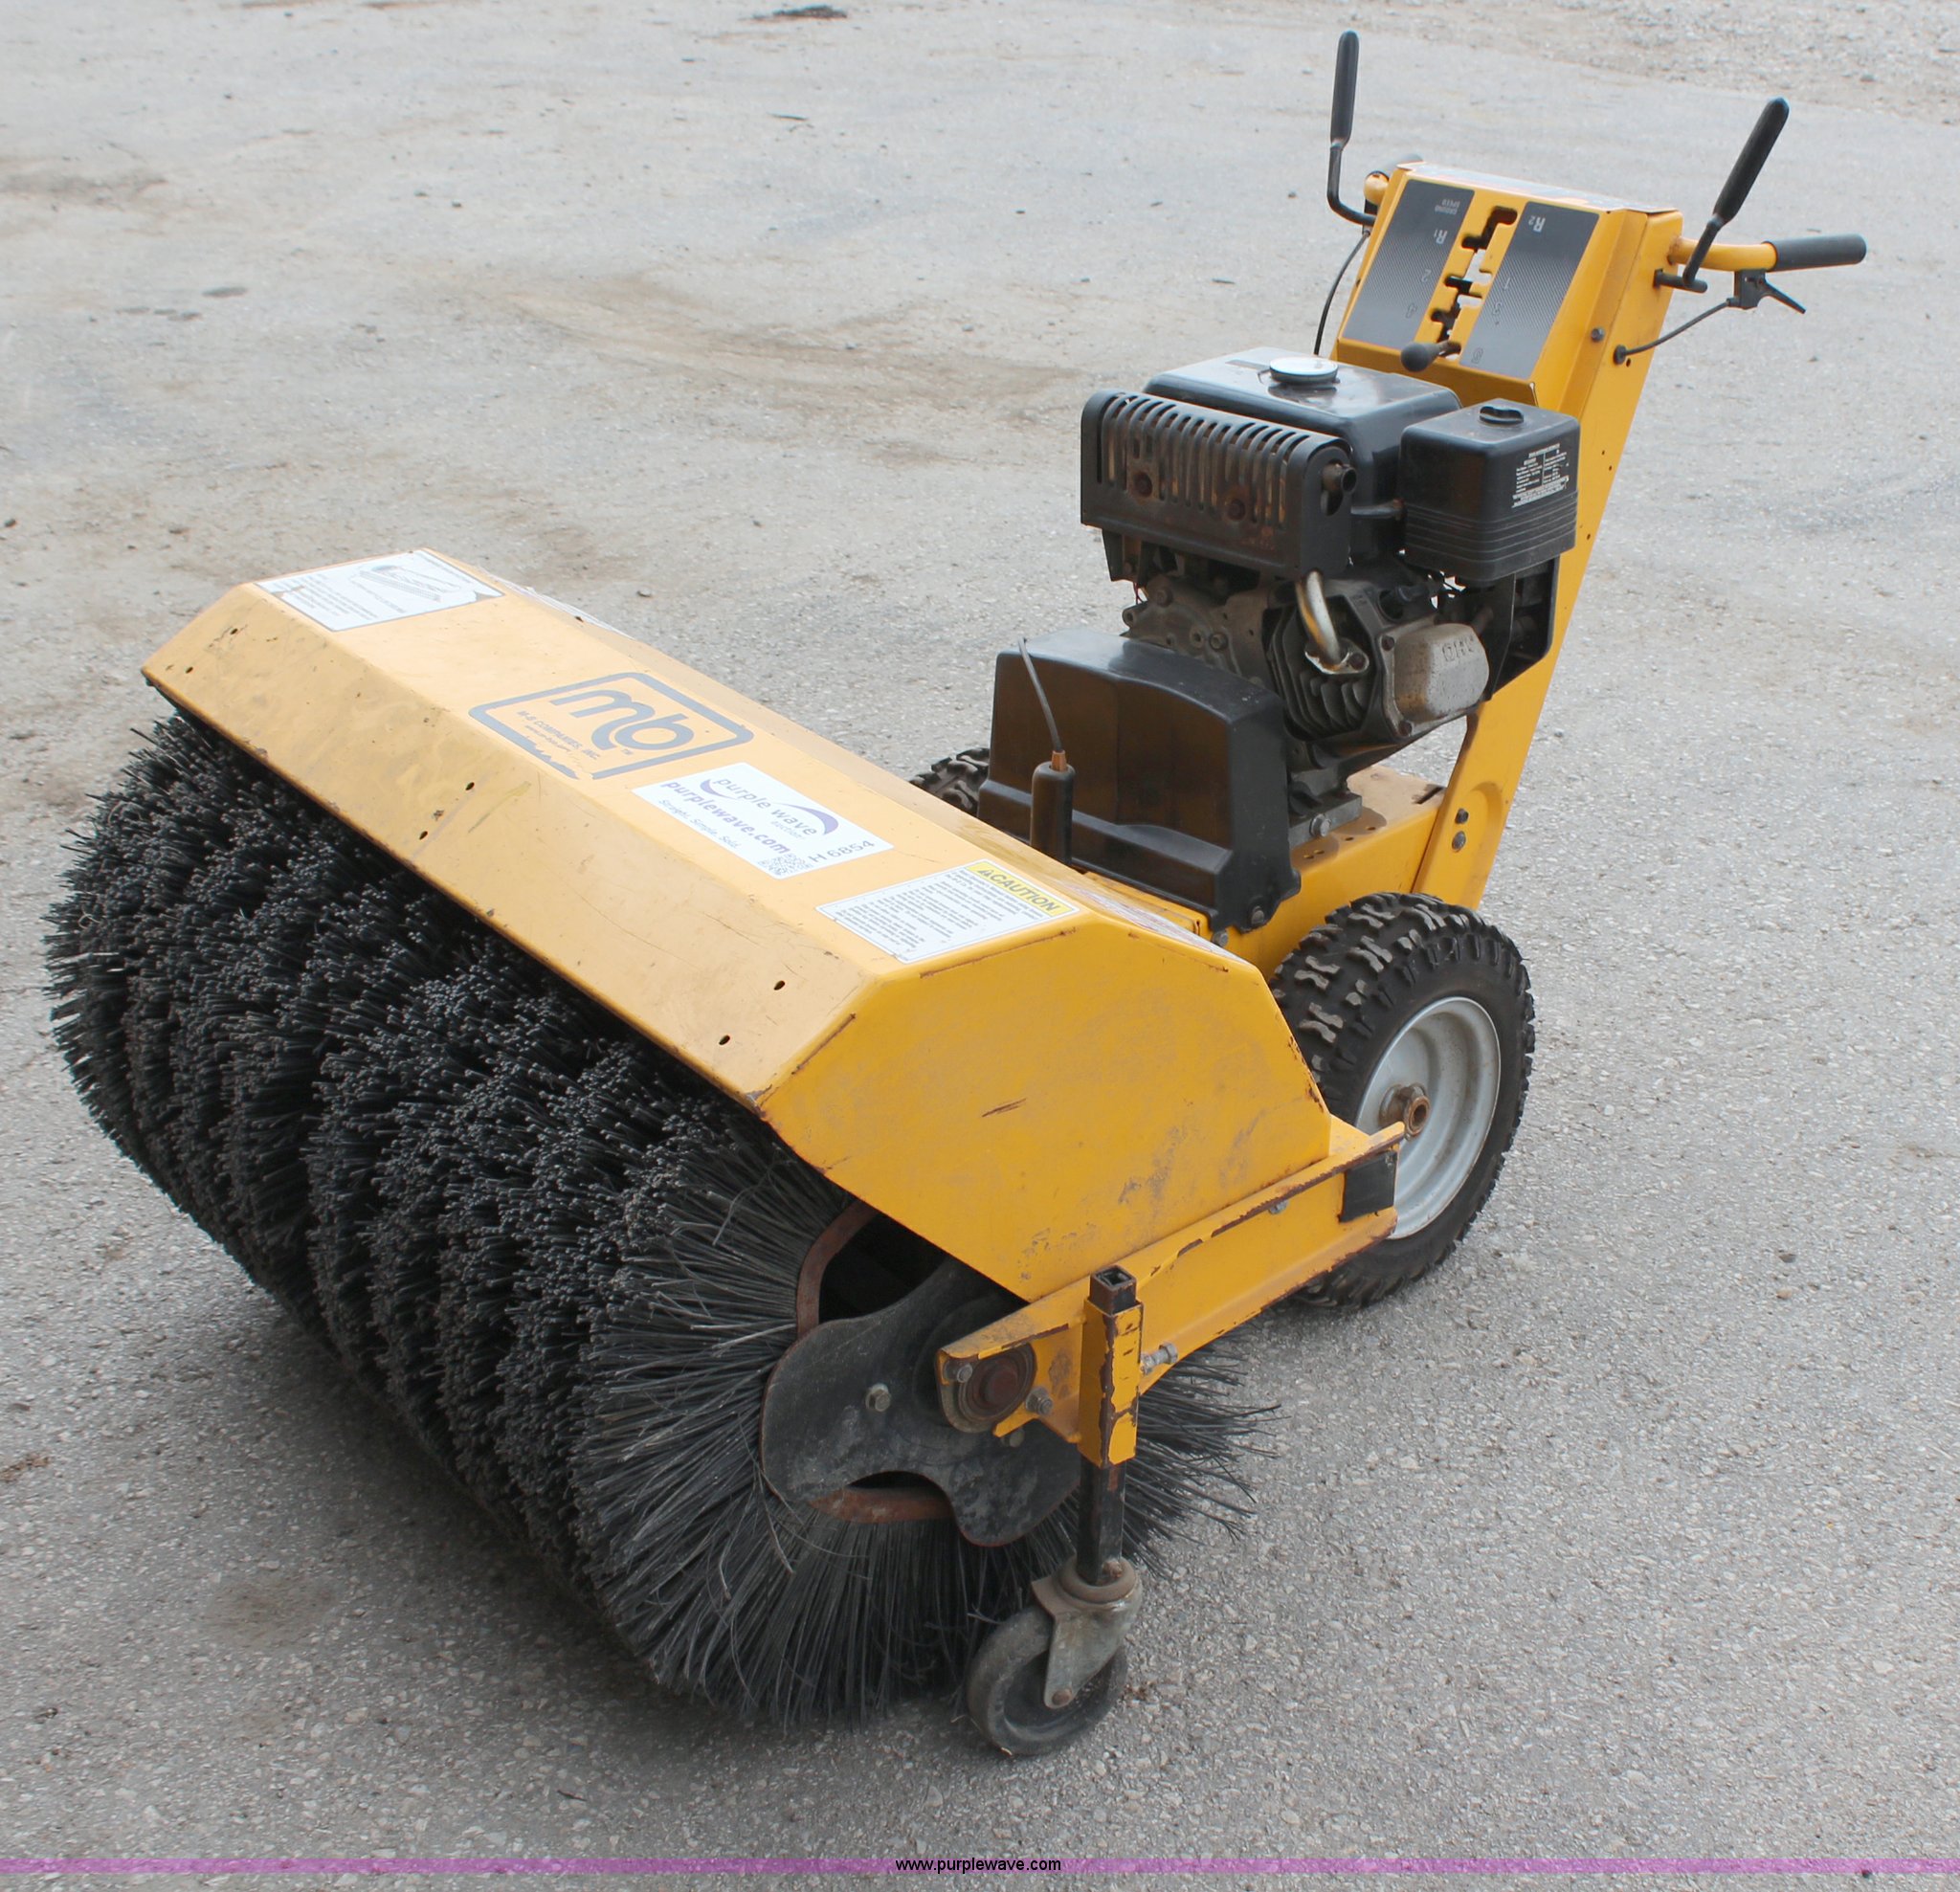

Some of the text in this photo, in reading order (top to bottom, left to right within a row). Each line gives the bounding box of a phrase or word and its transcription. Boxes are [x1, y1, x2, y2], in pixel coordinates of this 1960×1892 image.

[1420, 268, 1432, 283] 2
[659, 781, 791, 855] purplewave.com
[714, 777, 817, 835] purple wave
[808, 838, 875, 863] H 6854
[989, 871, 1064, 912] CAUTION
